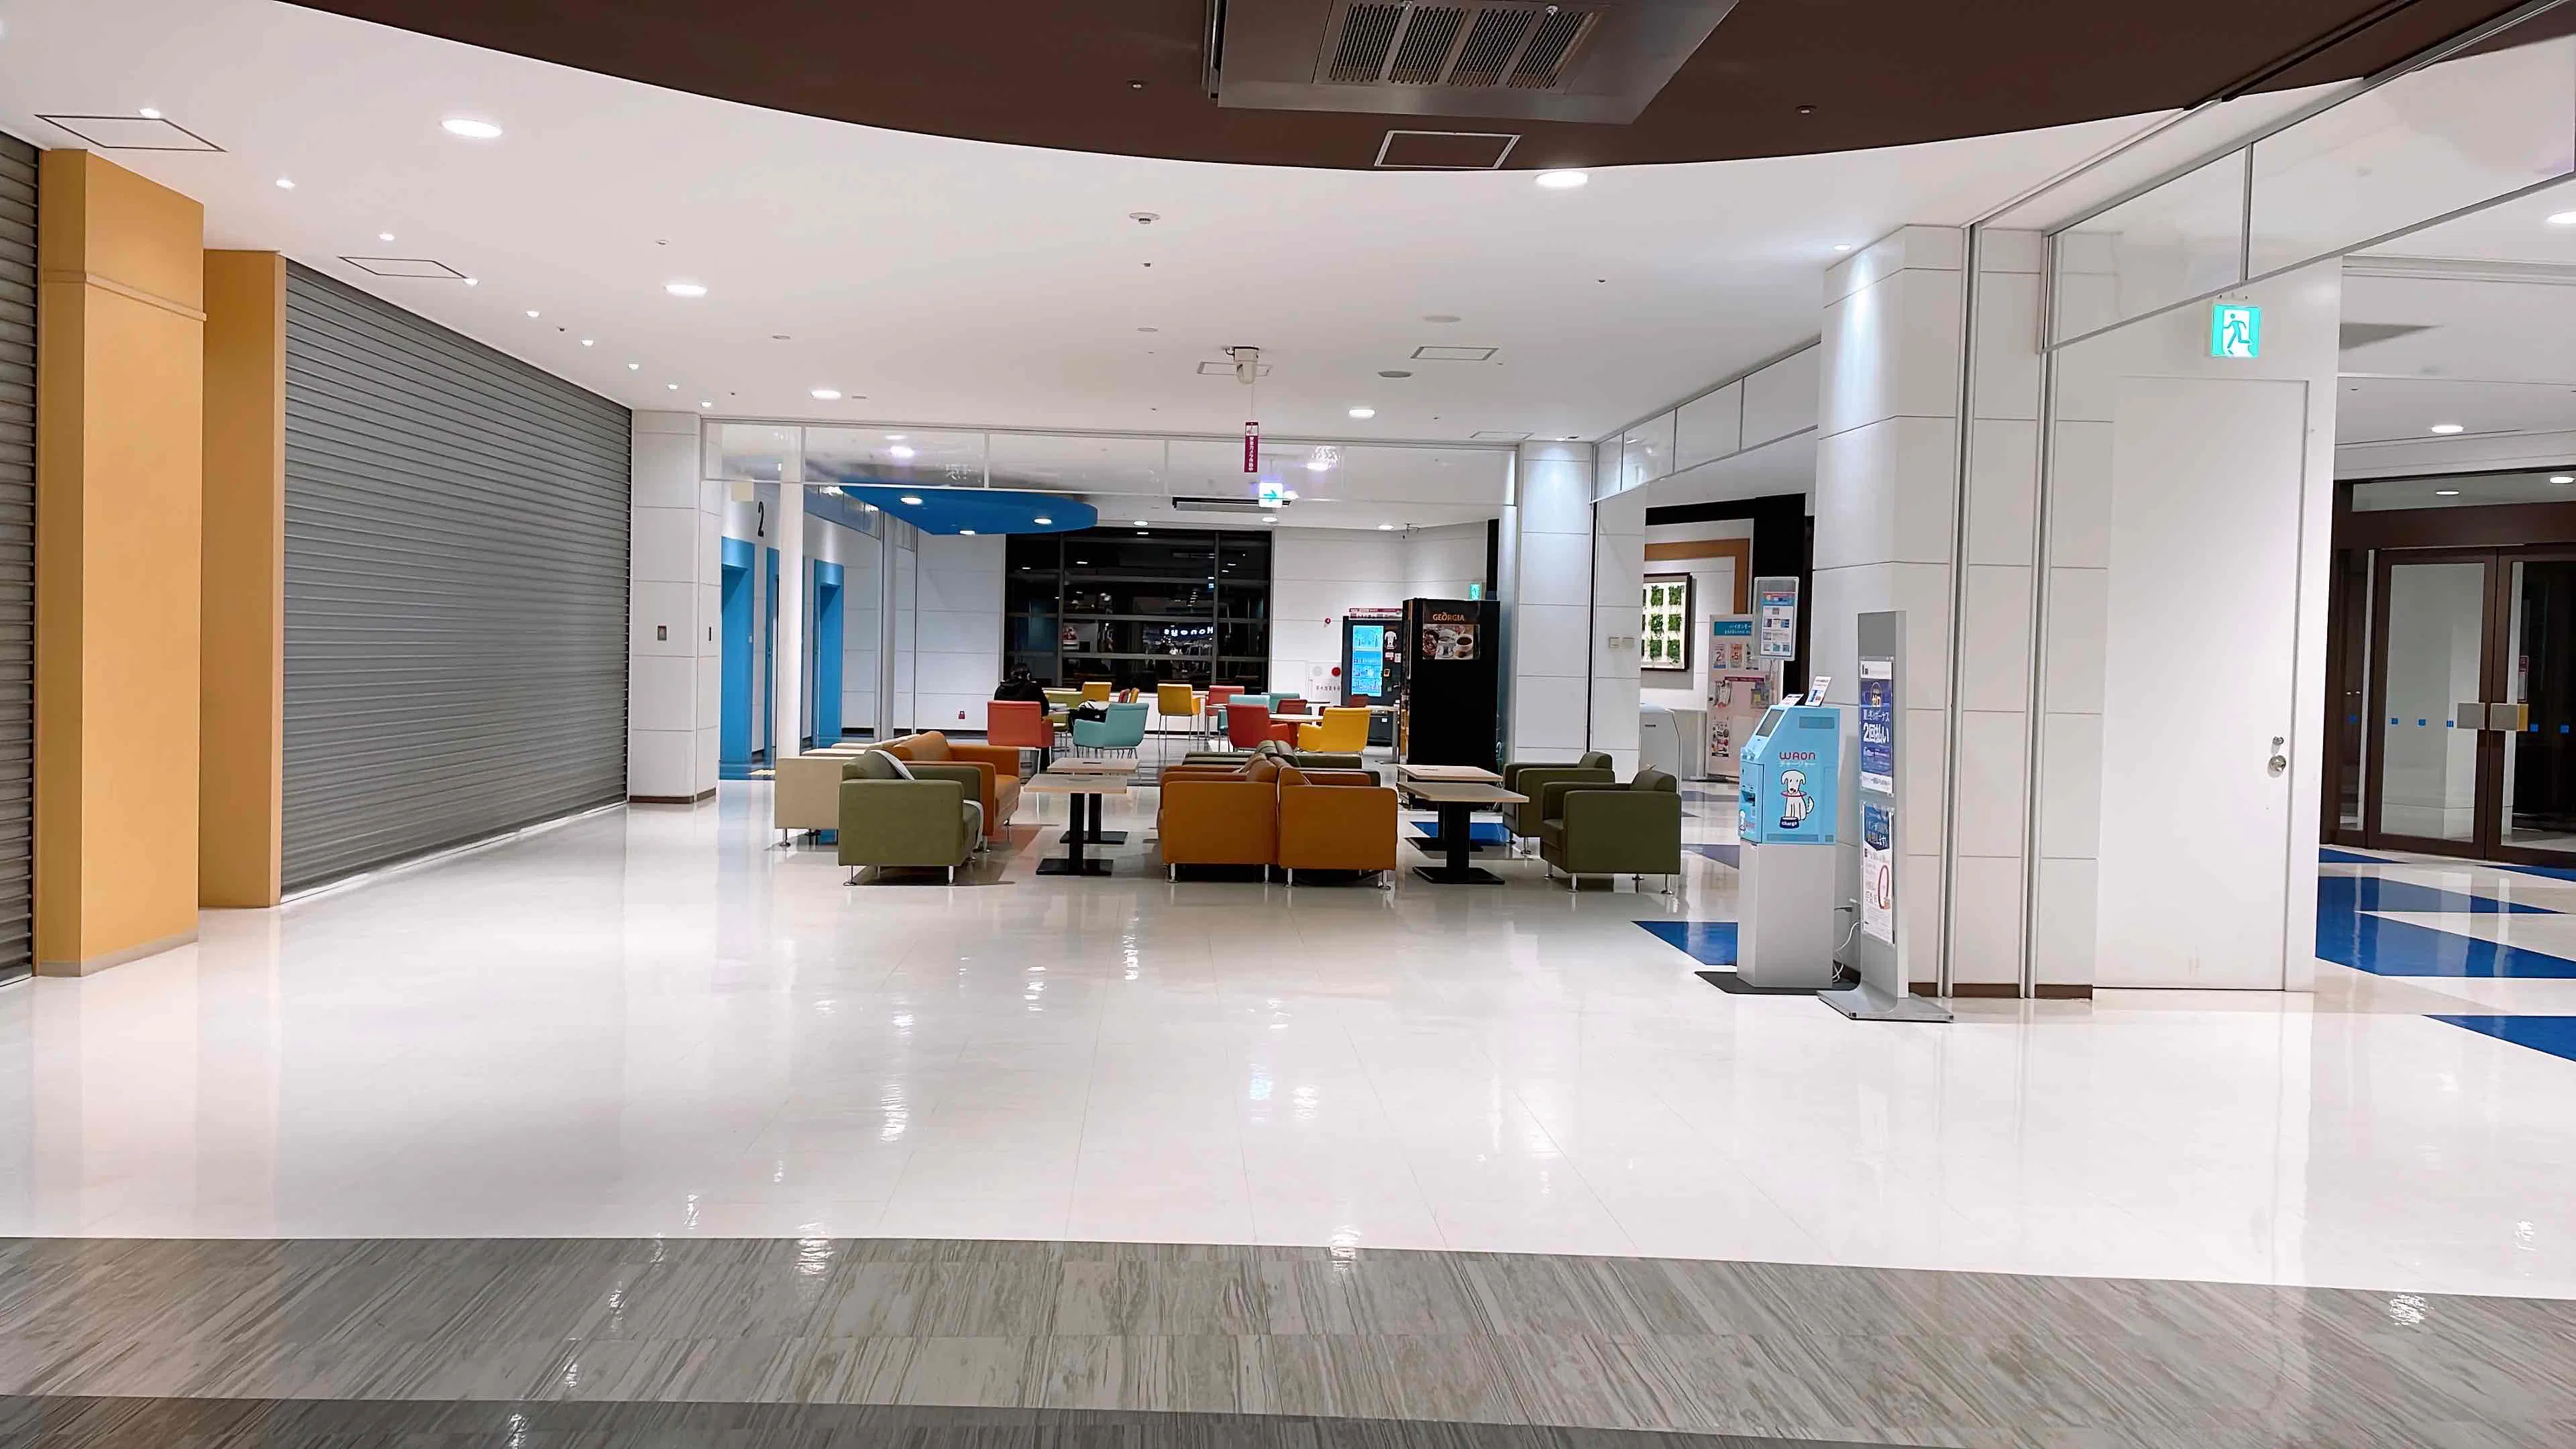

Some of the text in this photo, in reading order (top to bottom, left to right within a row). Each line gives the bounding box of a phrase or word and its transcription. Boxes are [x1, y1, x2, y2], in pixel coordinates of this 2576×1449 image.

[758, 501, 764, 537] 2
[1432, 612, 1464, 621] GEORGIA
[1863, 722, 1890, 744] 2回払い
[1779, 751, 1816, 761] WAON
